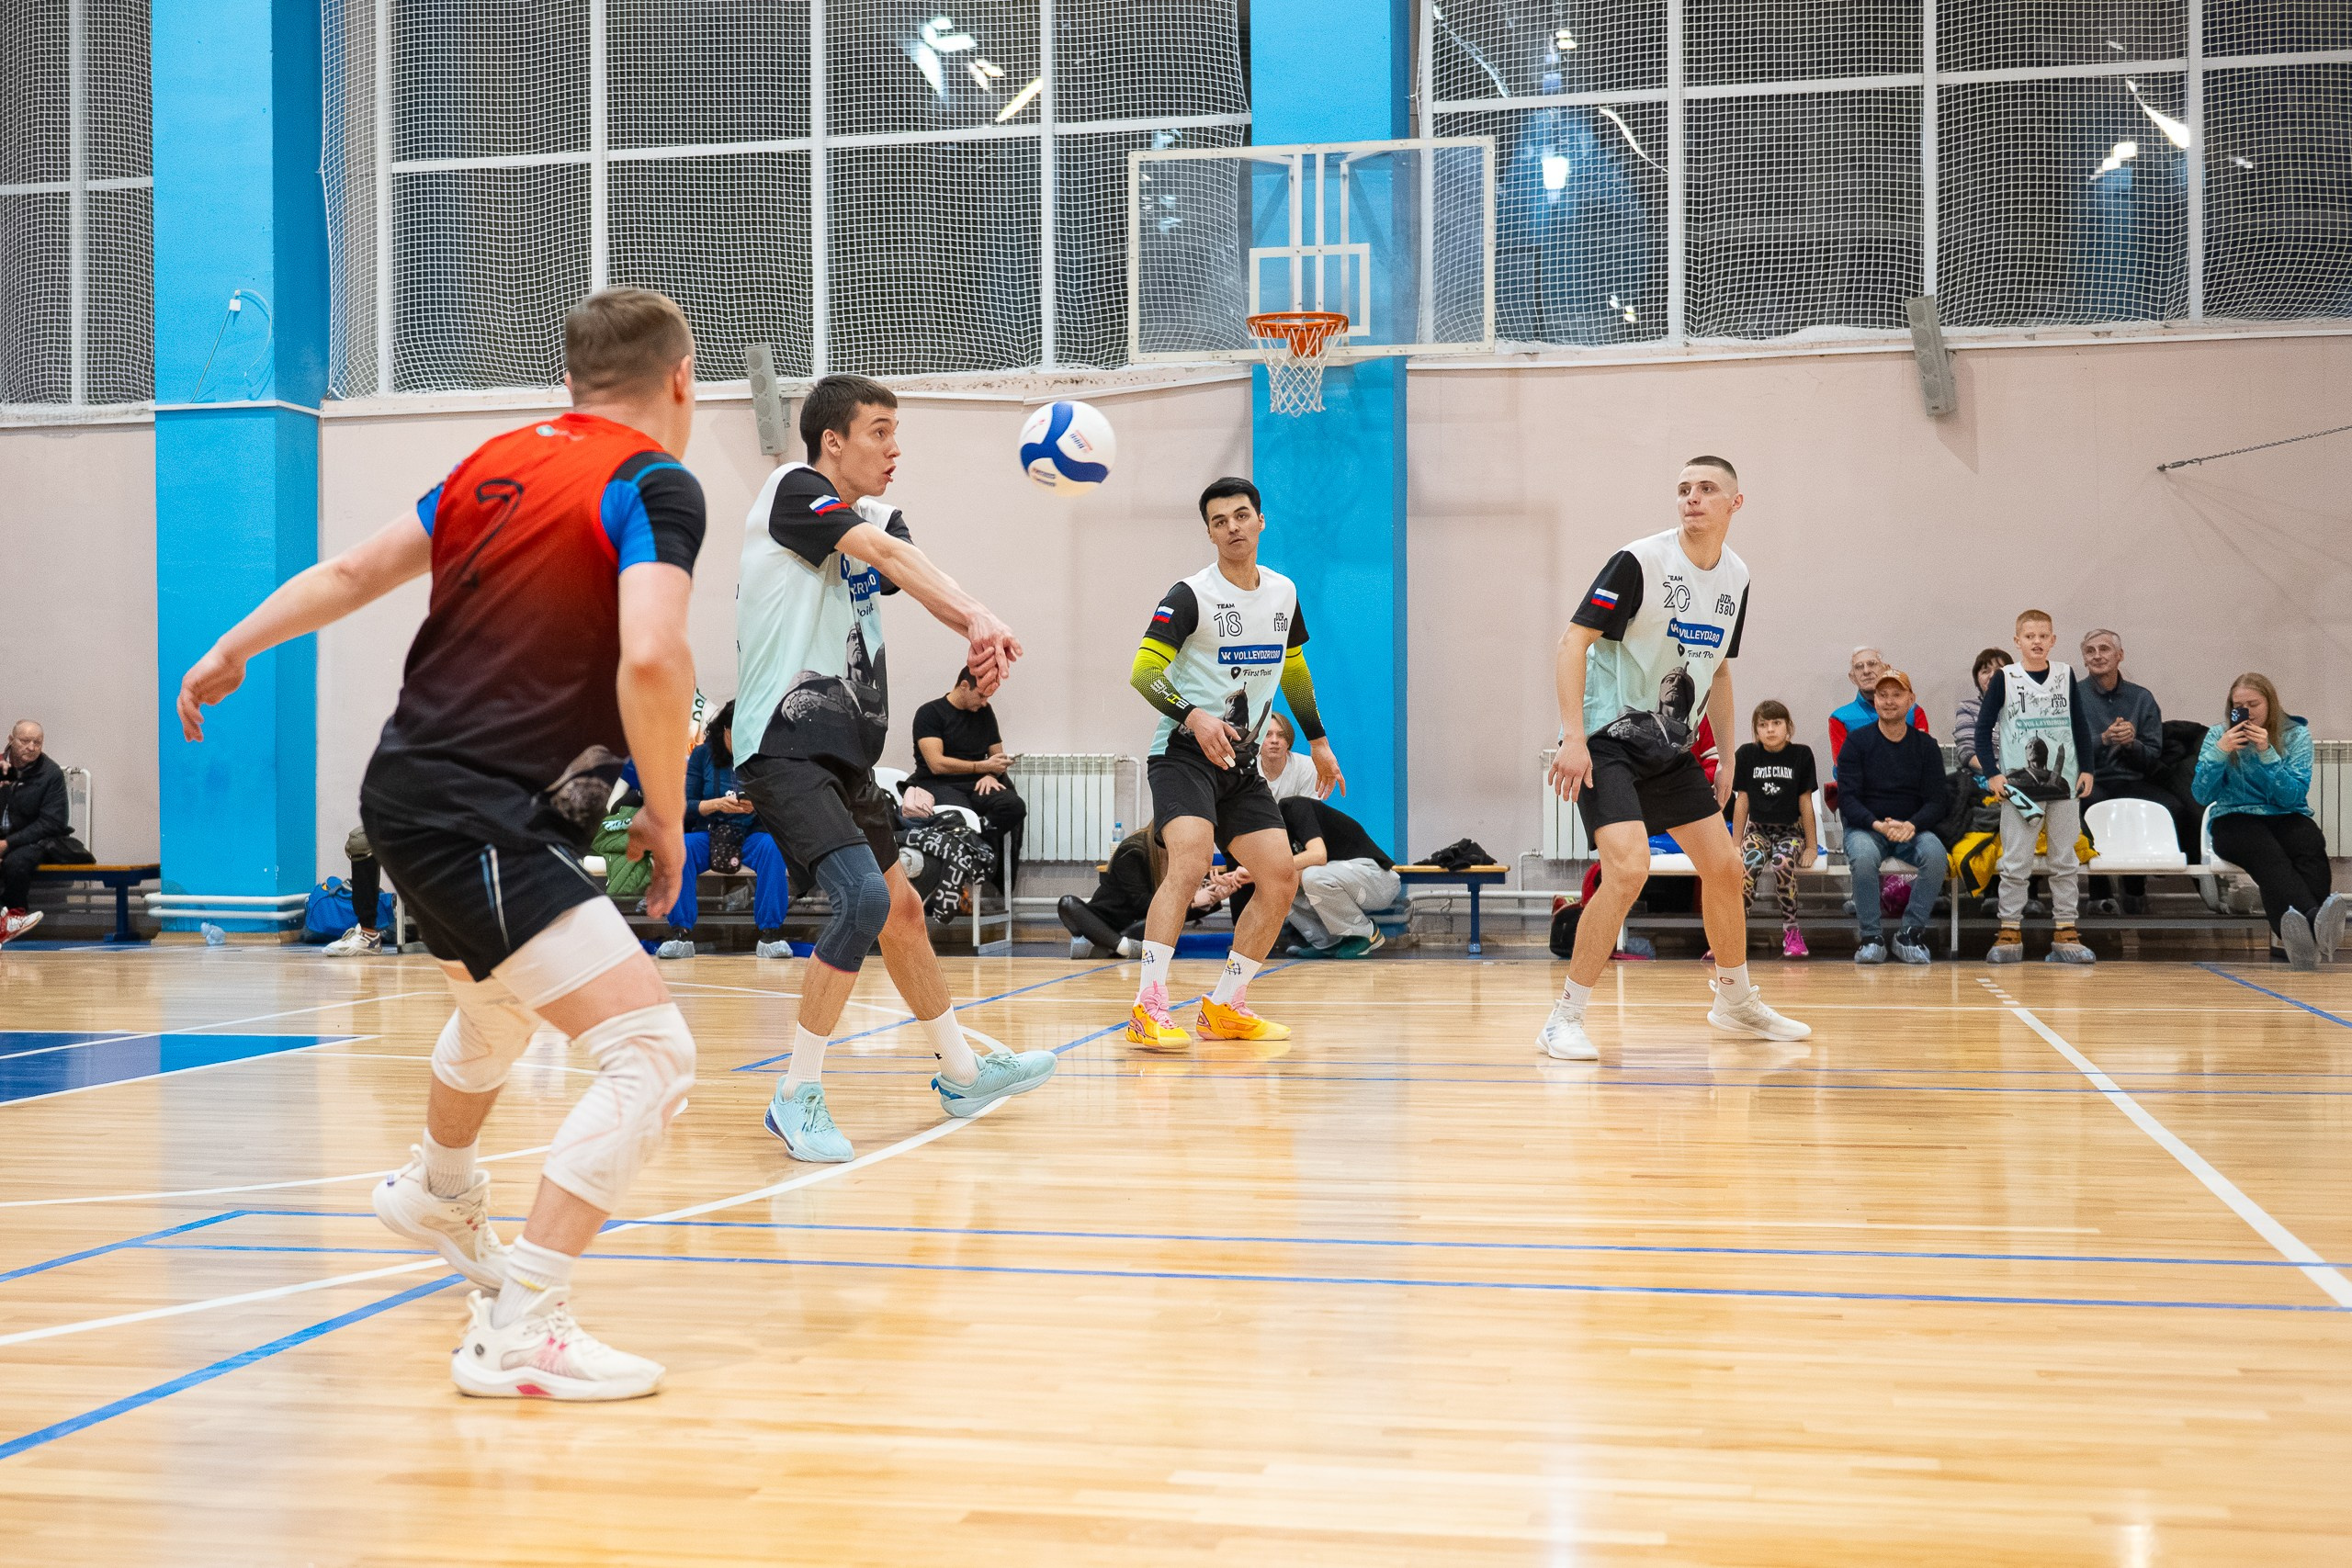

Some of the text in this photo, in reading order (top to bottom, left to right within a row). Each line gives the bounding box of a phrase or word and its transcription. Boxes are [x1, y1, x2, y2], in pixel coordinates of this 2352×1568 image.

[1663, 581, 1690, 612] 20
[1715, 599, 1735, 616] 1380
[1214, 611, 1243, 637] 18
[1242, 669, 1260, 677] First
